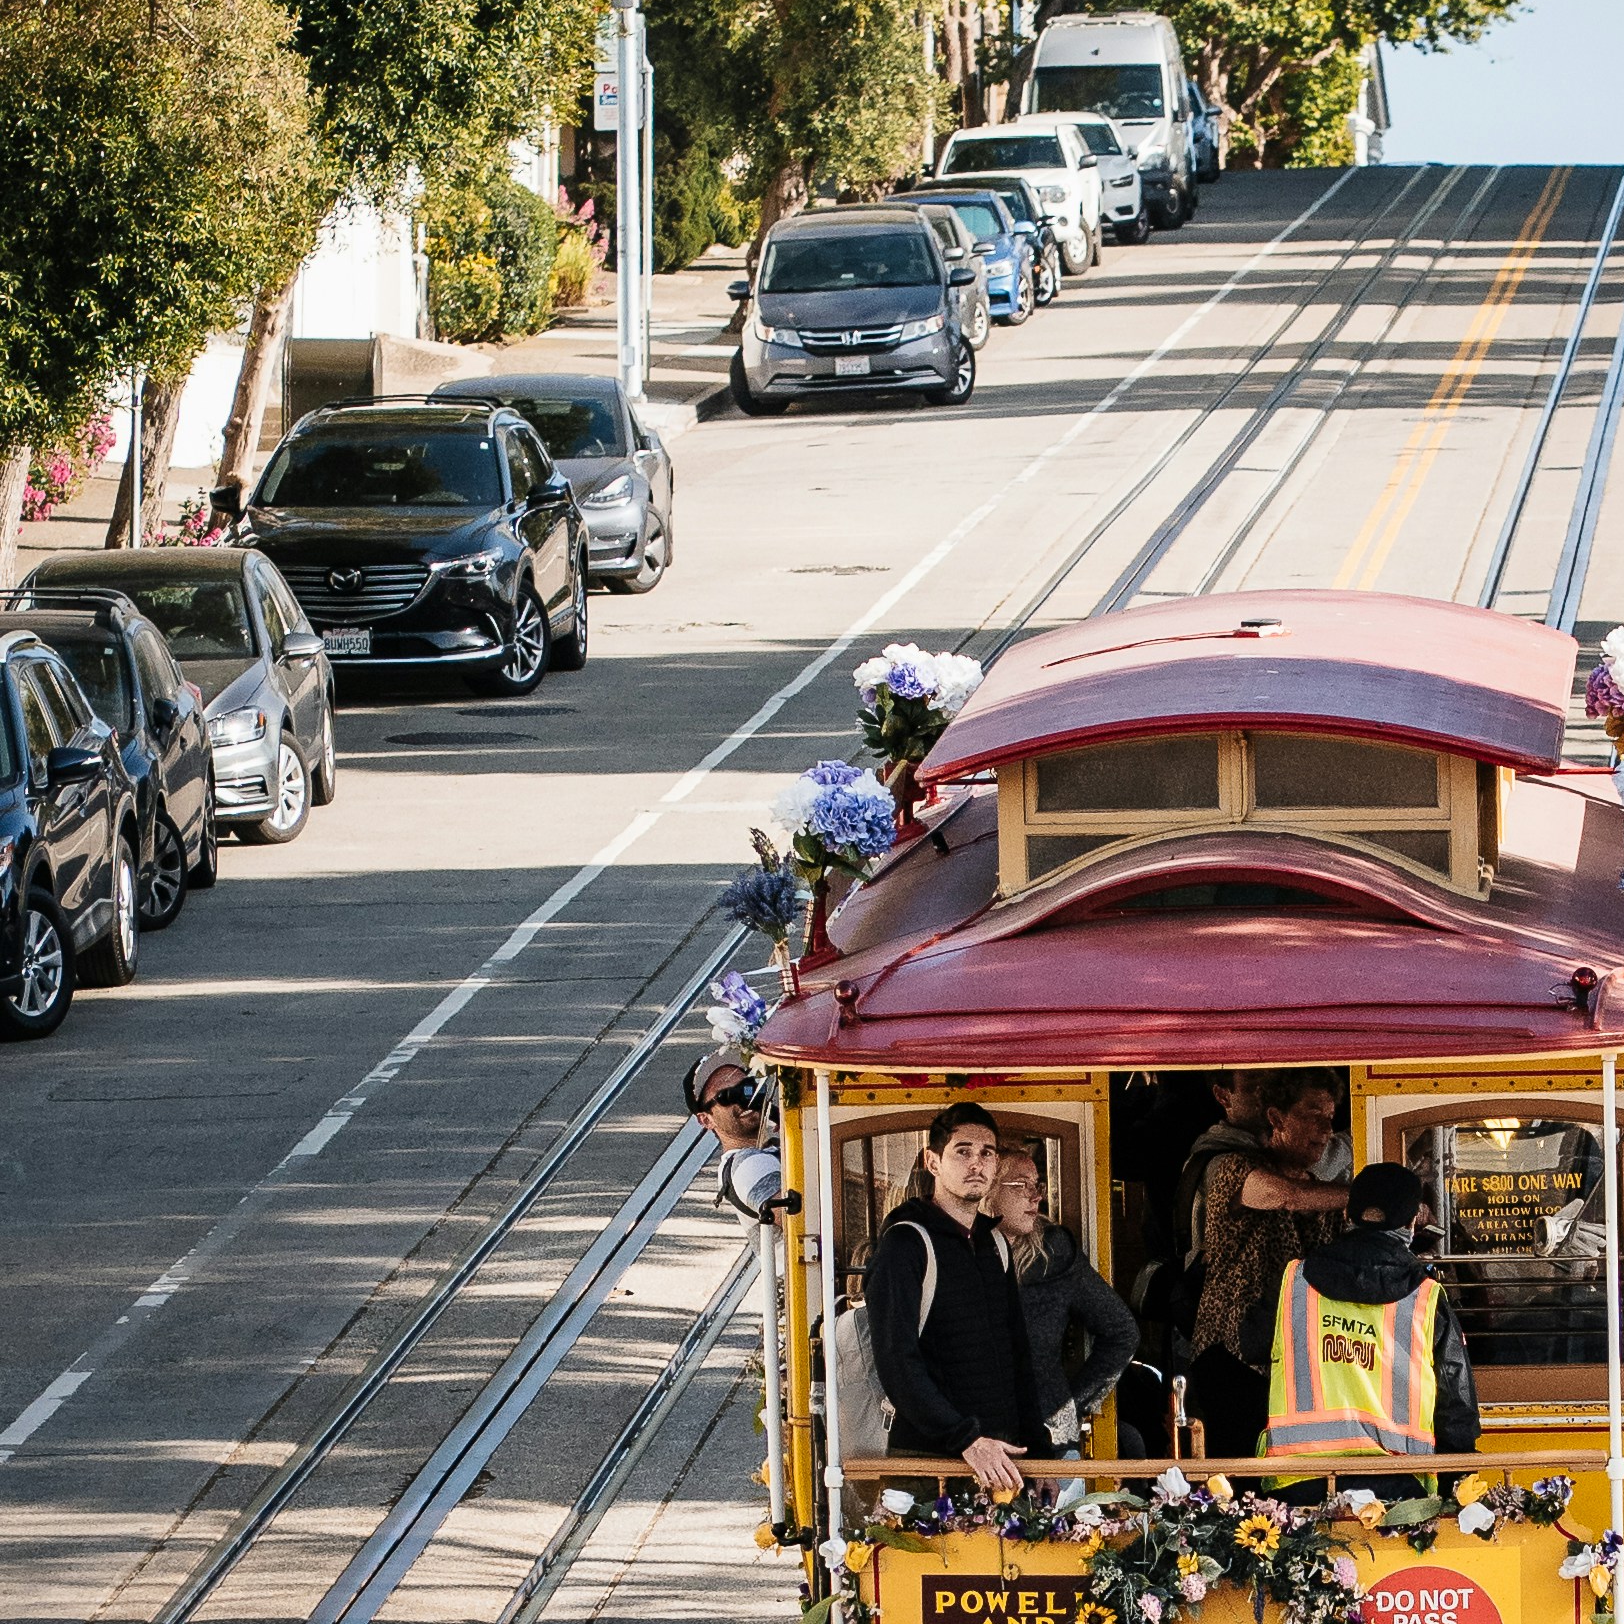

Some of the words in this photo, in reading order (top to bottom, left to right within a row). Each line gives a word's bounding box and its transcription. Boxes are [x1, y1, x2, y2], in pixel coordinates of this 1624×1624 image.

[1518, 1174, 1548, 1191] ONE
[1552, 1173, 1583, 1189] WAY
[1487, 1195, 1519, 1205] HOLD
[1523, 1194, 1540, 1203] ON
[1459, 1208, 1485, 1218] KEEP
[1488, 1207, 1531, 1217] YELLOW
[1535, 1205, 1563, 1215] FLOO
[1478, 1220, 1508, 1230] AREA
[1494, 1232, 1533, 1242] TRANS
[1322, 1314, 1377, 1337] SFMTA
[935, 1590, 1084, 1614] POWEL
[1376, 1590, 1415, 1613] DO
[1419, 1588, 1475, 1611] NOT
